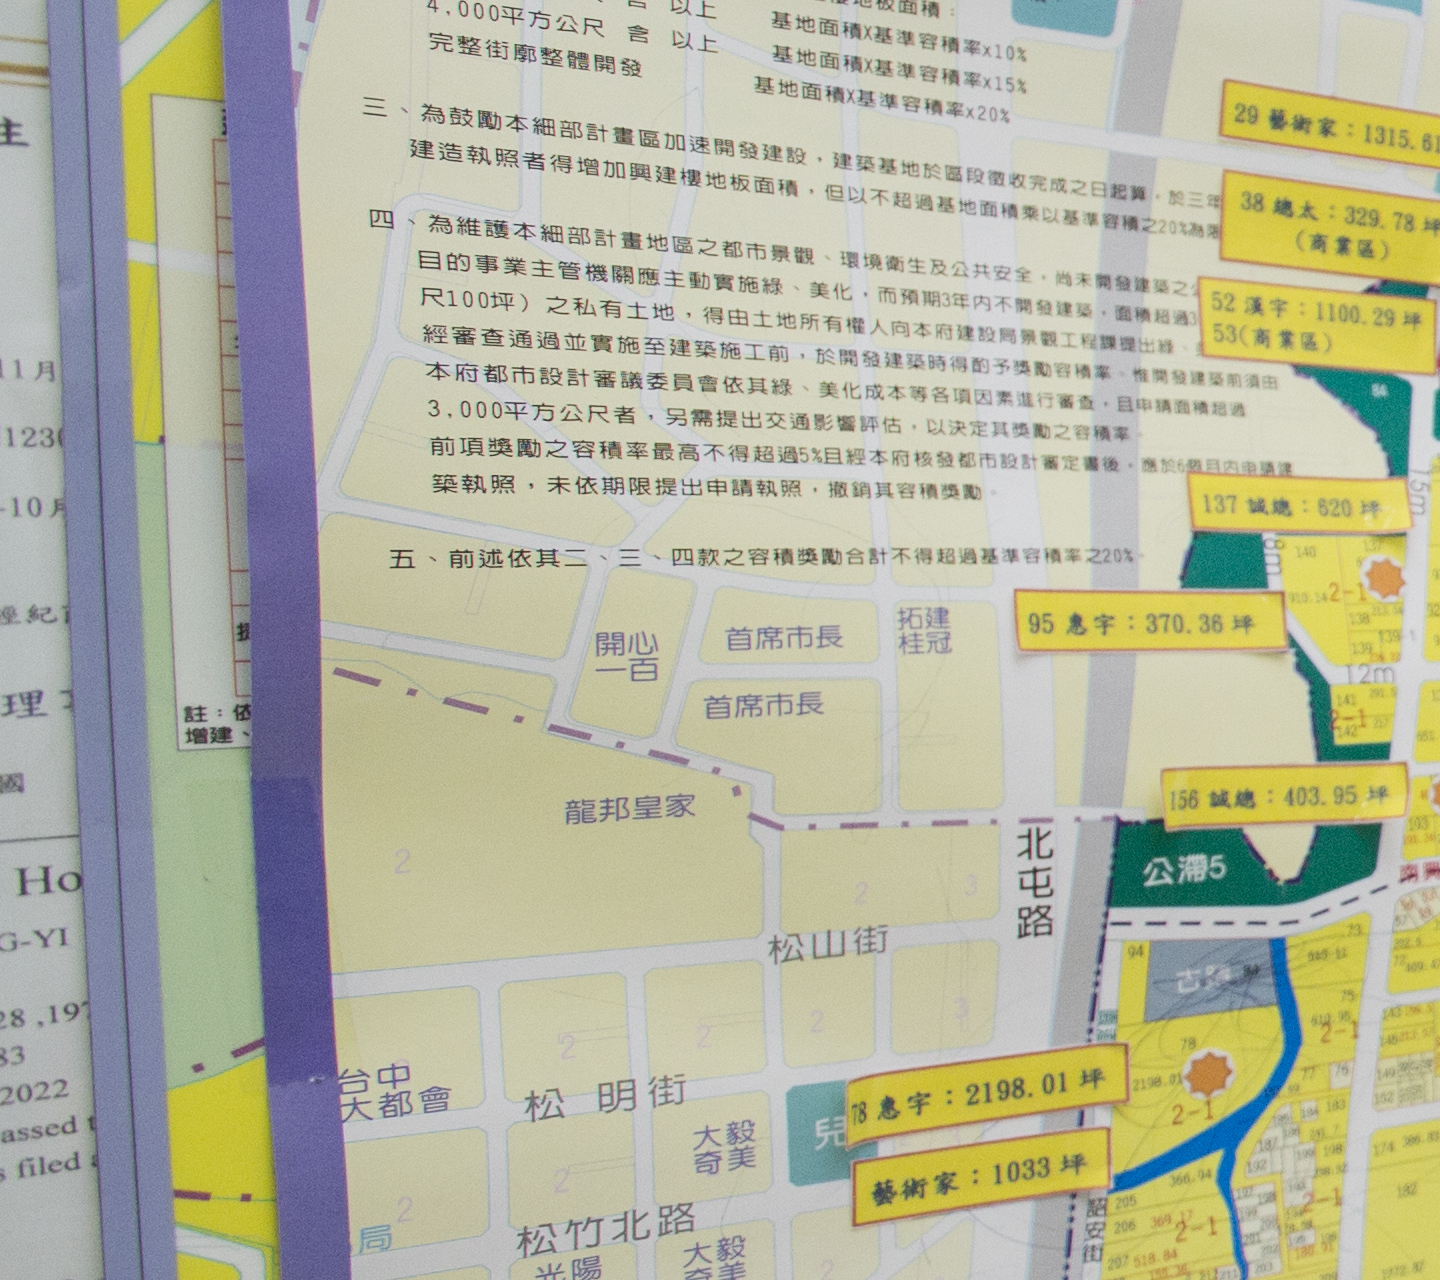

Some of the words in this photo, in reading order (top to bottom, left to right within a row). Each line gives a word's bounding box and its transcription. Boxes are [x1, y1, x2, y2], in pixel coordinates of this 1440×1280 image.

[428, 31, 643, 79] 完整街廓整體開發
[671, 29, 719, 54] 以上
[1234, 102, 1258, 125] 29
[1240, 191, 1265, 212] 38
[1211, 292, 1235, 313] 52
[1202, 494, 1238, 516] 137
[1409, 469, 1431, 517] 15m
[897, 606, 952, 631] 拓建
[1027, 613, 1055, 636] 95
[594, 631, 660, 657] 開心
[724, 624, 845, 652] 首席市長
[898, 631, 953, 656] 桂冠
[594, 657, 660, 683] 一百
[1345, 664, 1395, 685] 12m
[703, 691, 826, 719] 首席市長
[564, 793, 696, 826] 龍邦皇家
[1169, 789, 1199, 812] 156
[1015, 824, 1055, 940] 北屯路
[1143, 856, 1228, 887] 公滯5
[767, 924, 890, 964] 松山街
[0, 1078, 69, 1107] 2022
[337, 1063, 412, 1095] 台中
[339, 1084, 452, 1122] 大都會
[18, 1150, 81, 1181] filed
[516, 1202, 696, 1259] 松竹北路
[682, 1235, 748, 1266] 大毅
